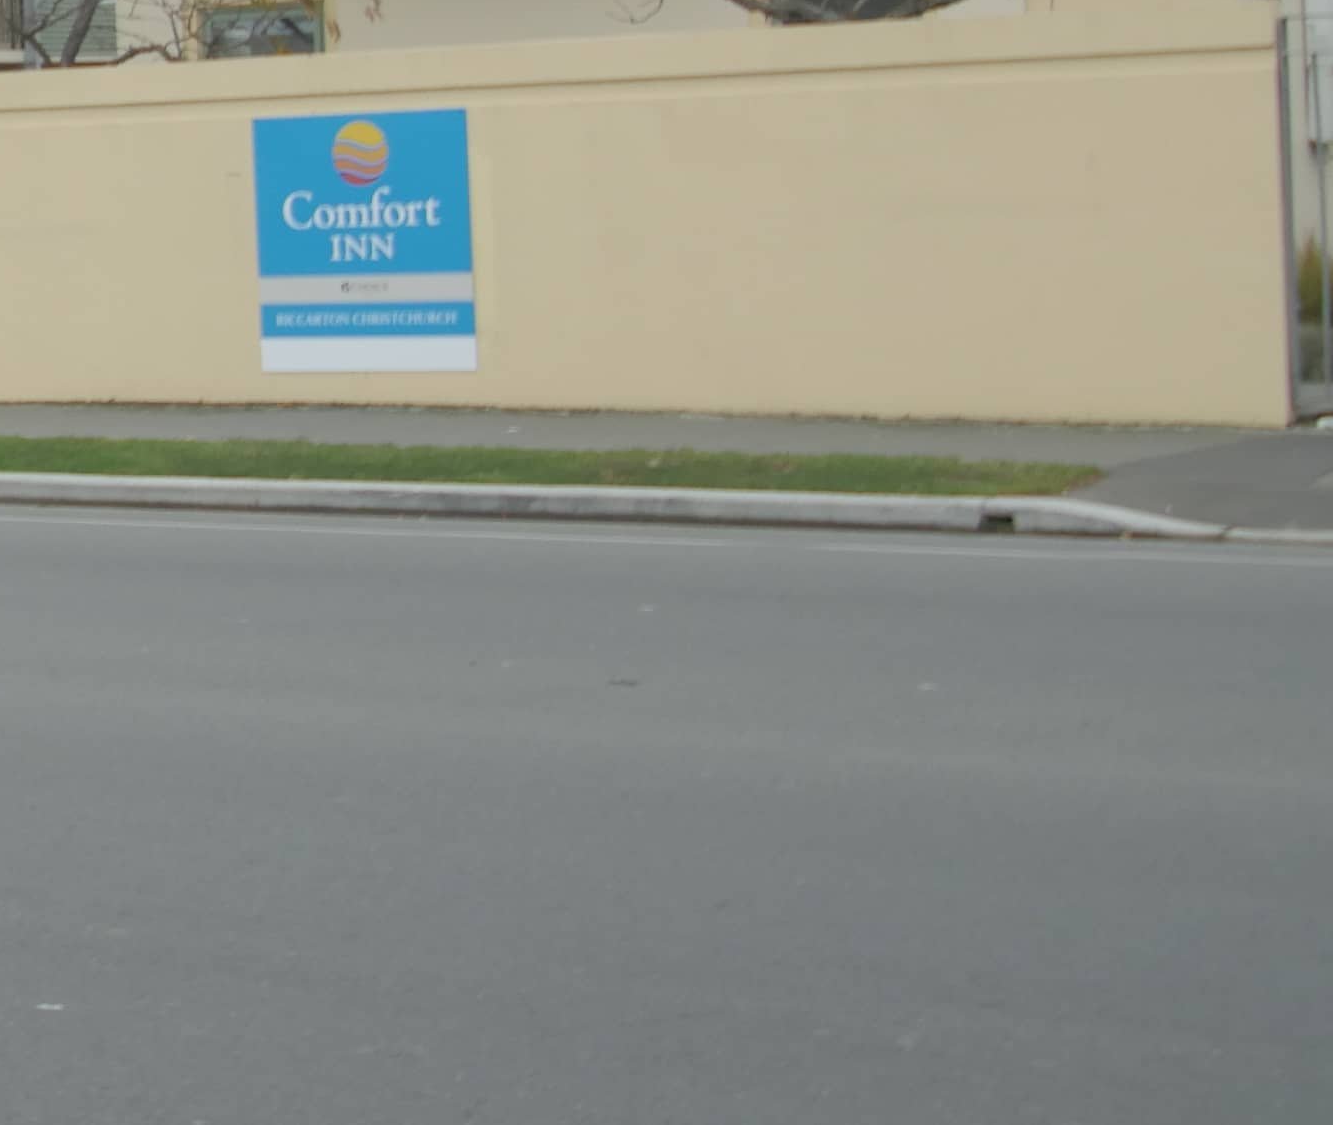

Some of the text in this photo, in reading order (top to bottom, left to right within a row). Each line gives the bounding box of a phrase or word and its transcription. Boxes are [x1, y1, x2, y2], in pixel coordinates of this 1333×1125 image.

[282, 186, 441, 230] Comfort
[330, 232, 395, 262] INN
[276, 311, 349, 328] RICCARTON
